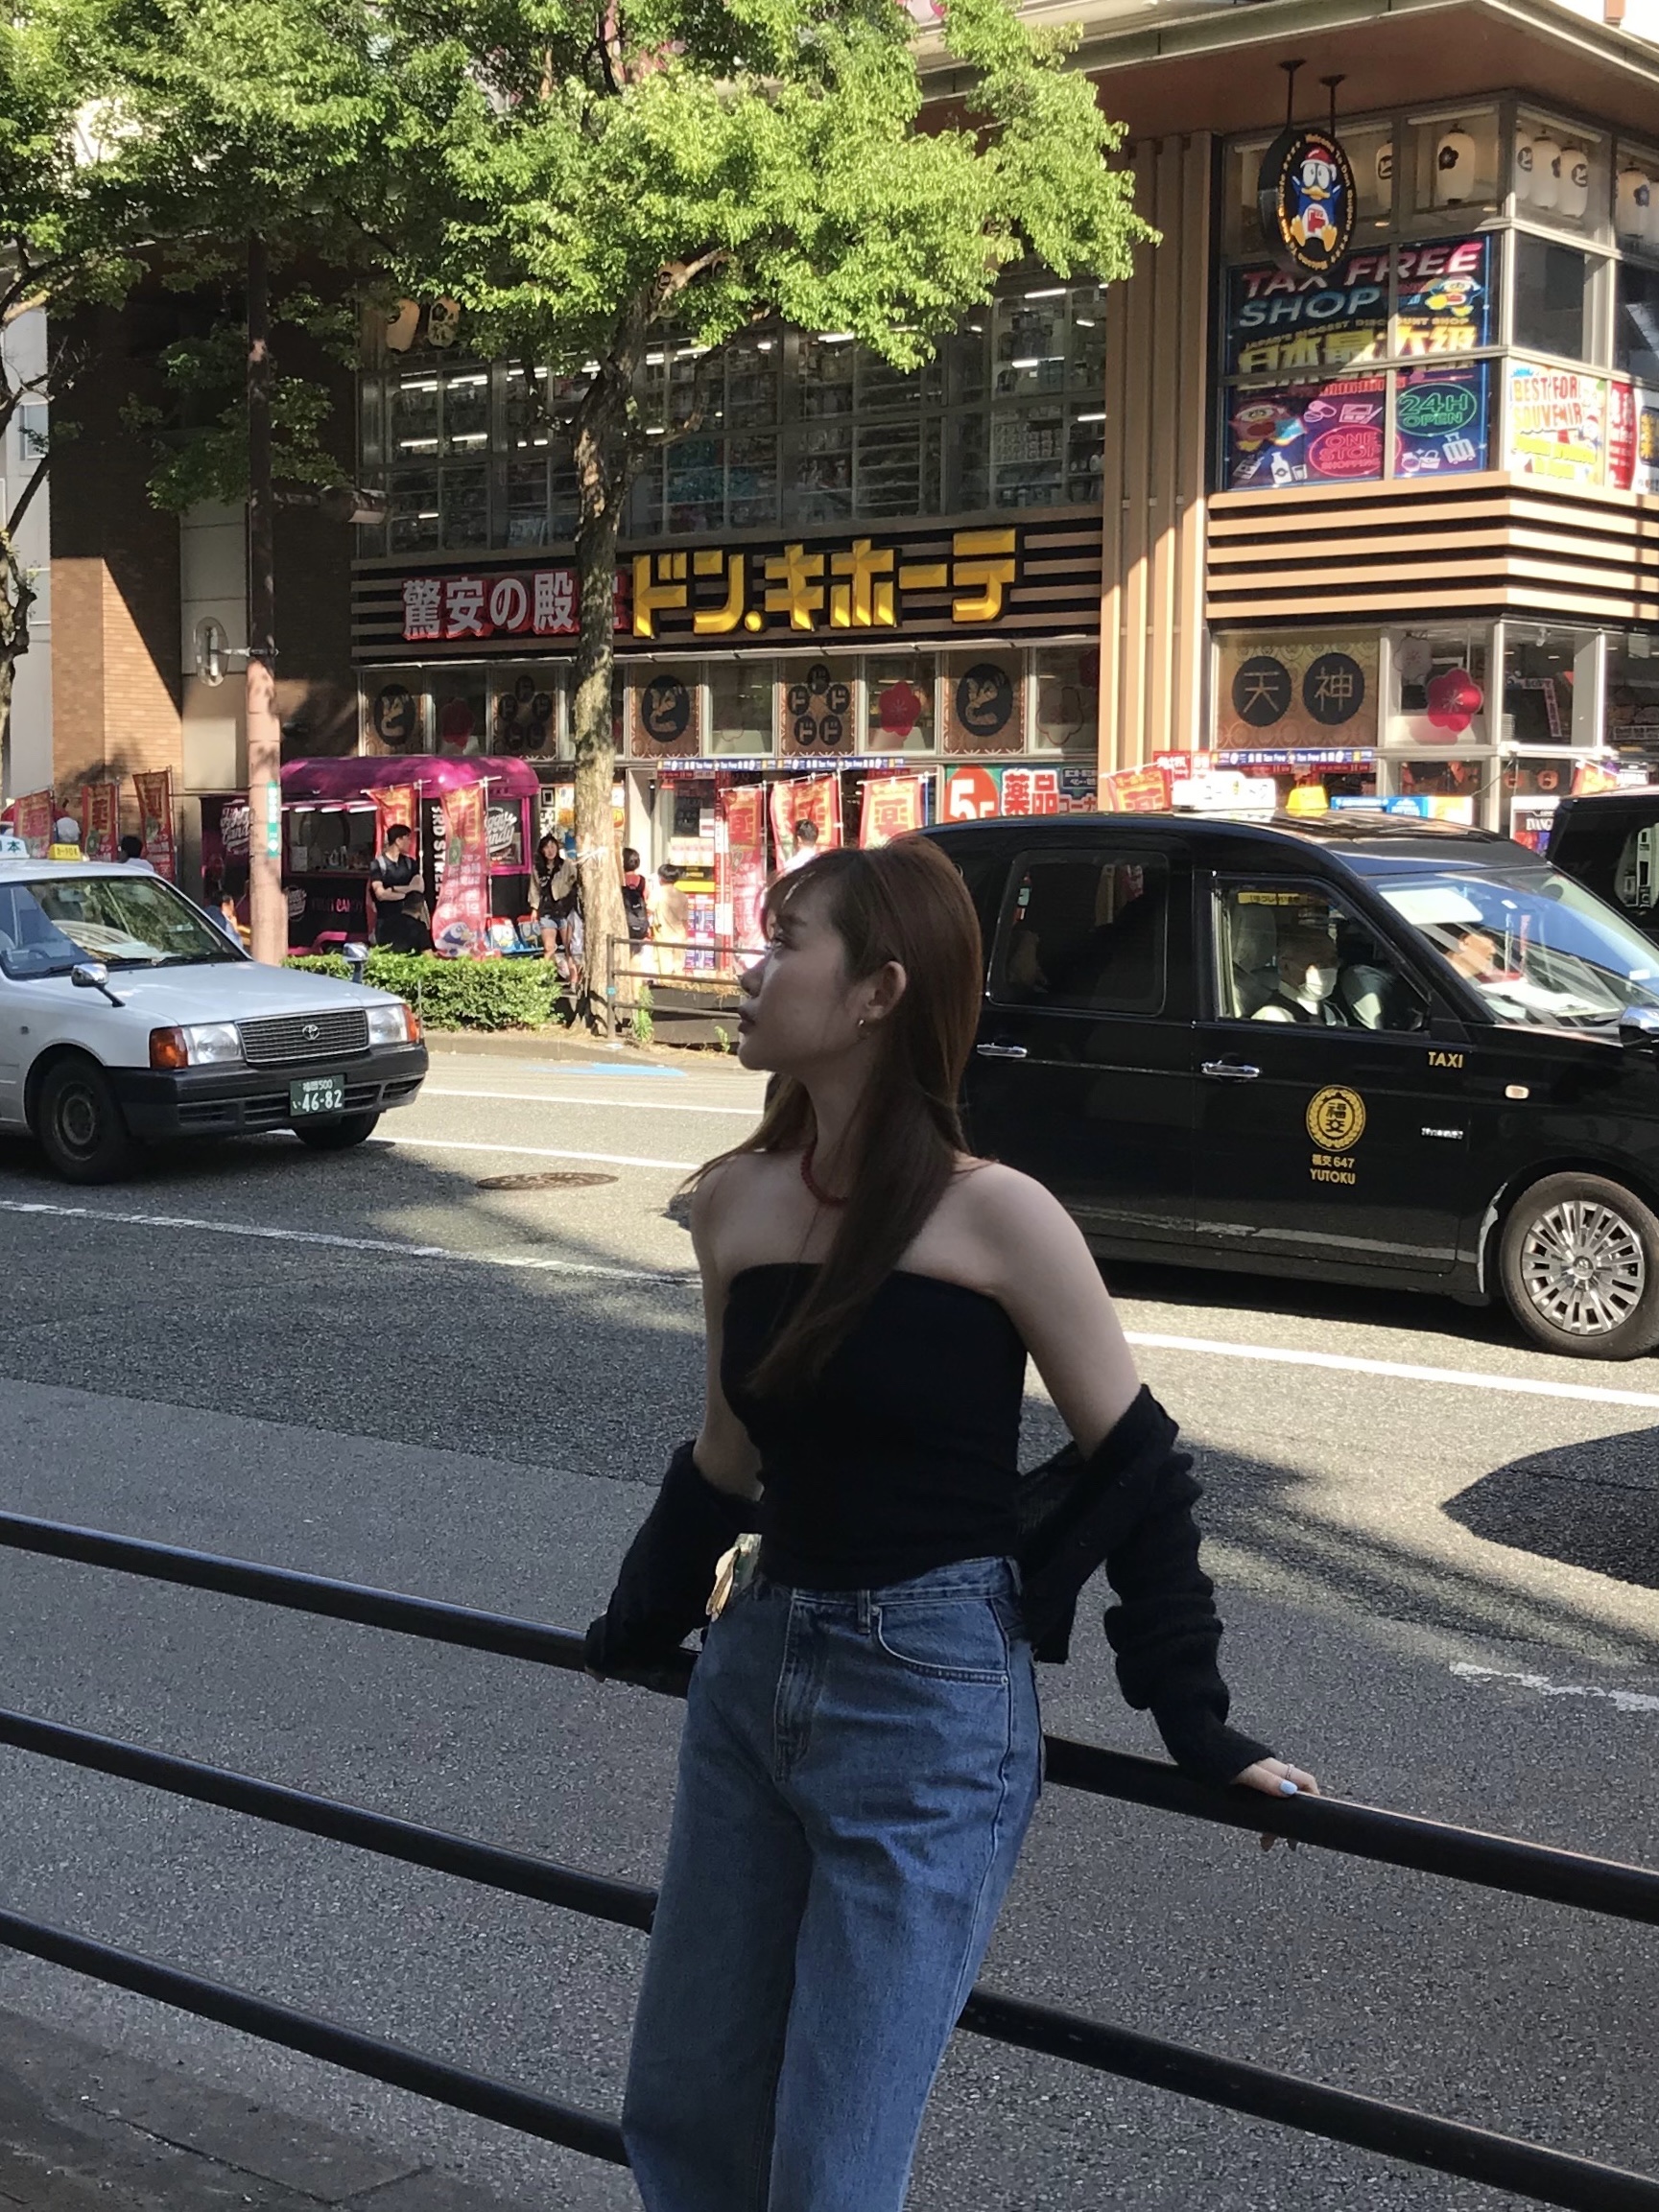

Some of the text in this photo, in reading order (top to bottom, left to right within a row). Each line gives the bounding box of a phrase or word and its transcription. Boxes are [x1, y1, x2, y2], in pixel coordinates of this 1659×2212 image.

[1344, 243, 1483, 286] FREE
[1239, 288, 1380, 327] SHOP
[1513, 375, 1578, 402] BEST FOR
[1398, 392, 1469, 415] 24H
[1403, 412, 1463, 428] OPEN
[1326, 431, 1380, 447] ONE
[1319, 444, 1382, 460] STOP
[403, 572, 619, 636] 驚安の殿
[1243, 667, 1354, 714] 天神
[1003, 768, 1058, 815] 薬品
[1428, 1051, 1464, 1069] TAXI
[1334, 1156, 1355, 1169] 647
[1310, 1168, 1356, 1186] YUTOKU
